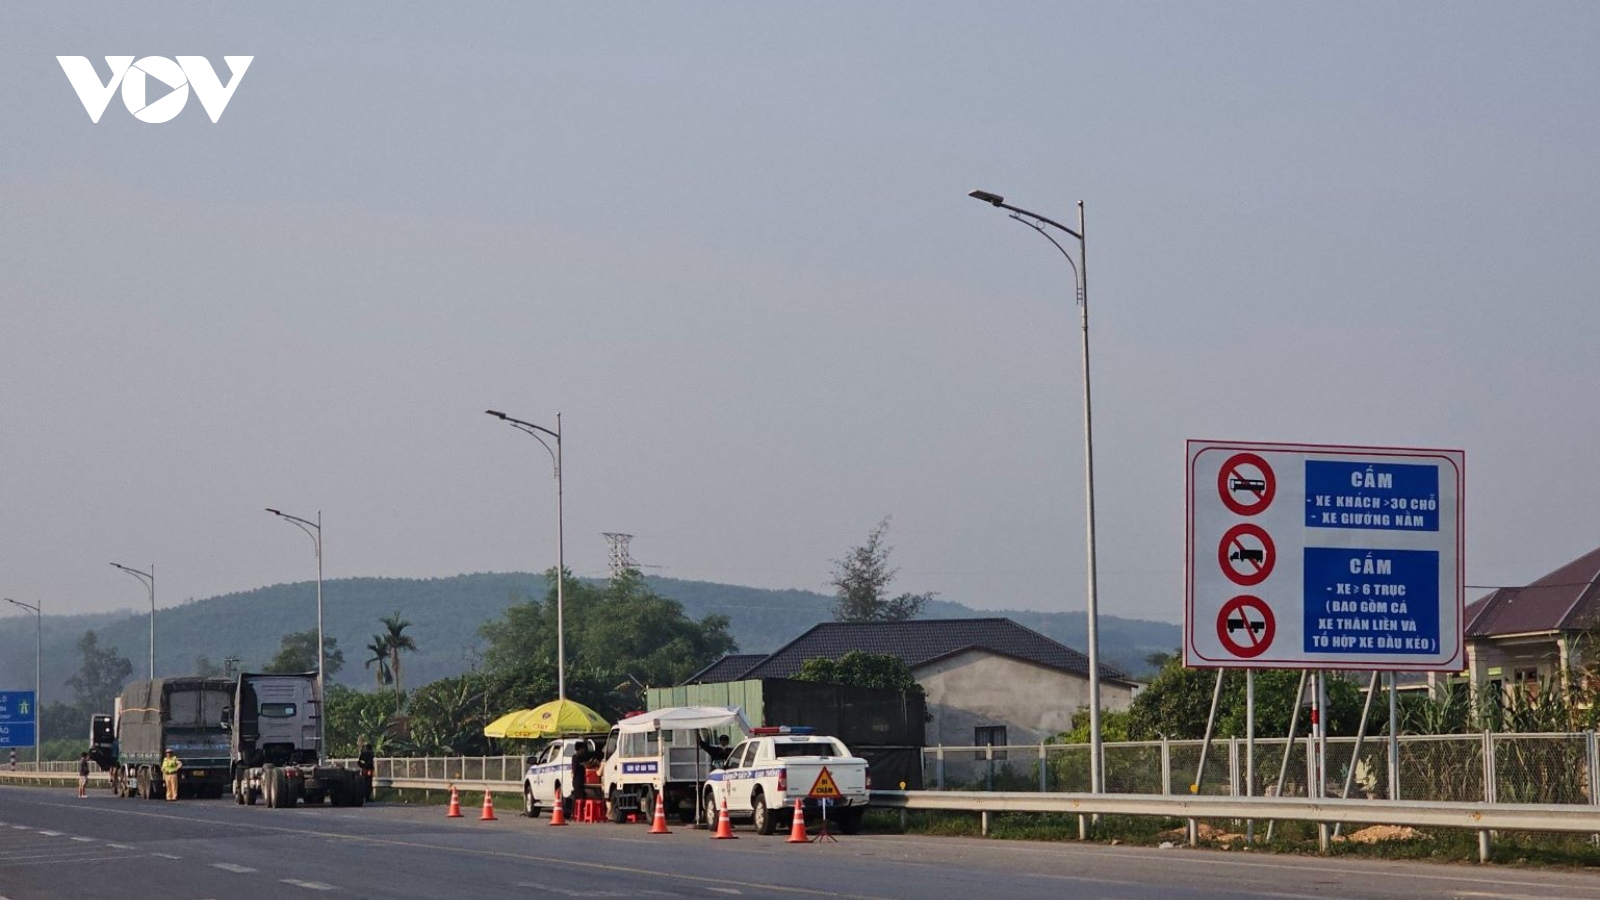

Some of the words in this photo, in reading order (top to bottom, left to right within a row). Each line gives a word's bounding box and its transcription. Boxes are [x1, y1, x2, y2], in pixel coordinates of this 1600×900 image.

[1351, 465, 1392, 488] CẤM
[1316, 495, 1331, 506] XE
[1336, 492, 1380, 508] KHÁCH
[1410, 494, 1436, 510] CHỖ
[1322, 512, 1337, 523] XE
[1350, 552, 1391, 574] CẤM
[1337, 583, 1351, 594] XE
[1363, 584, 1370, 595] 6
[1374, 584, 1406, 598] TRỤC
[1360, 598, 1387, 613] GỒM
[1319, 618, 1333, 630] XE
[1336, 616, 1369, 630] THÂN
[1372, 615, 1398, 631] LIỀN
[1401, 618, 1417, 631] VÀ
[1359, 637, 1374, 648] XE
[1377, 633, 1402, 649] ĐẦU
